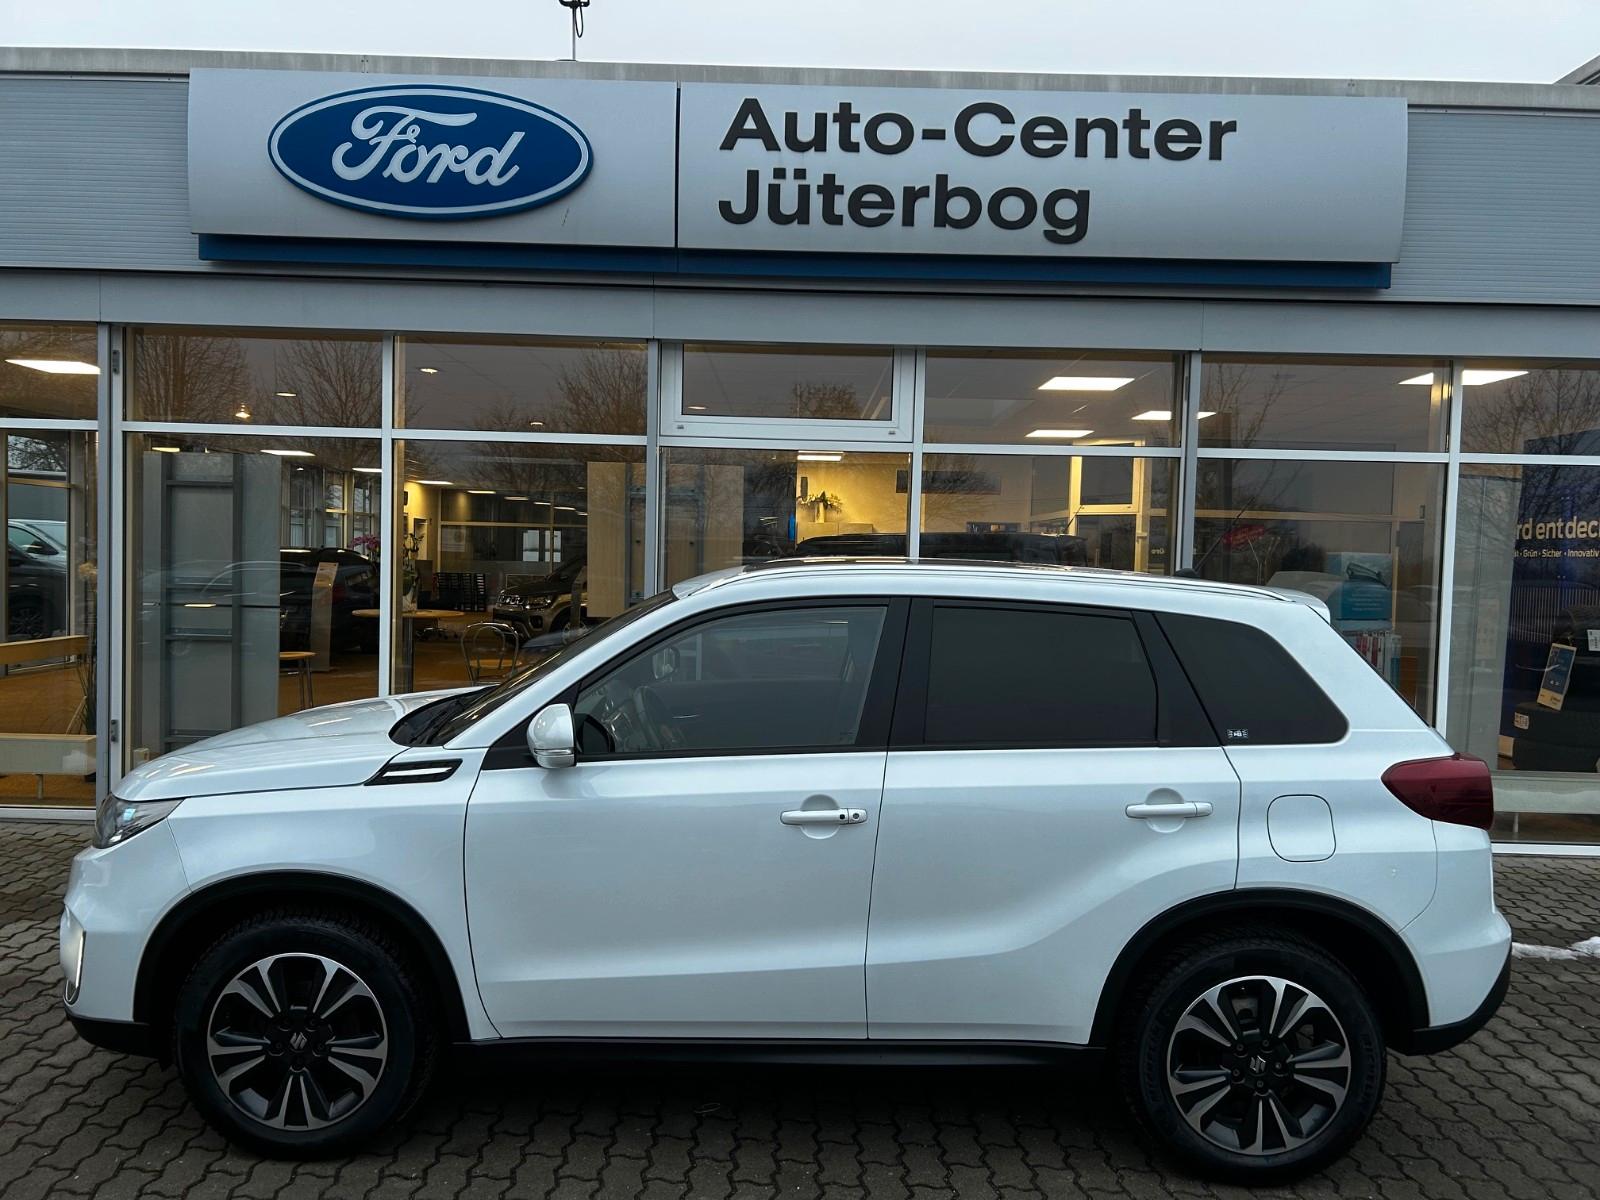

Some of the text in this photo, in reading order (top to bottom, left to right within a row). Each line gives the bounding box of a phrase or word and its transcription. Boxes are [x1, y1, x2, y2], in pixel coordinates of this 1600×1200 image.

[332, 105, 525, 186] Ford
[719, 98, 1237, 161] Auto-Center
[718, 167, 1090, 244] Jüterbog
[1536, 516, 1600, 539] entdec
[1542, 549, 1561, 557] Sicher
[1567, 548, 1600, 557] Innovativ
